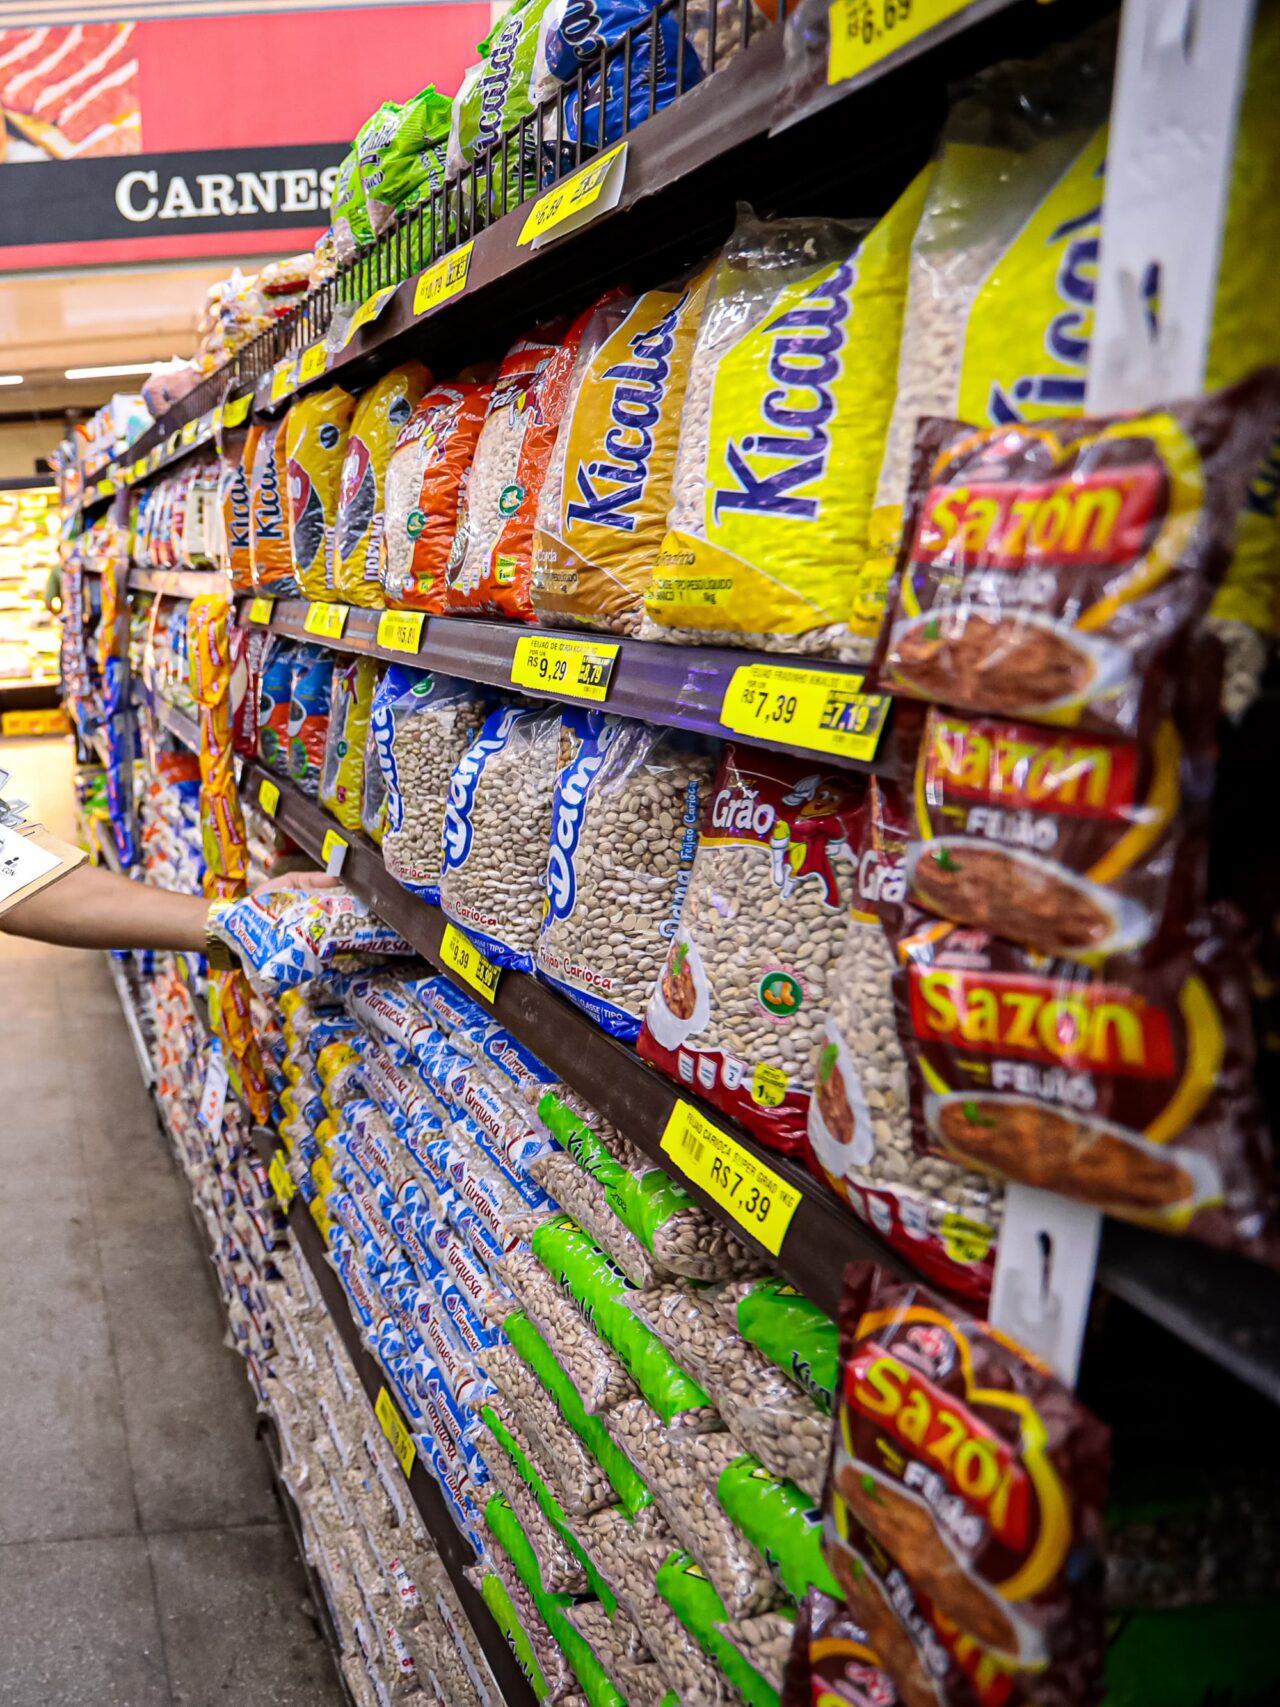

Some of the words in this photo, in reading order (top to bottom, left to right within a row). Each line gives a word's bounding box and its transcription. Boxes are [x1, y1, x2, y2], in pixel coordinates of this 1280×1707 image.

[114, 166, 337, 222] CARNES
[539, 658, 568, 682] 9,29
[754, 691, 799, 725] 7,39
[711, 788, 777, 835] Grão
[856, 848, 908, 902] Grã
[454, 901, 498, 928] Carioca
[452, 946, 471, 970] 9,39
[488, 943, 506, 954] TIPO
[562, 957, 614, 991] Carioca
[365, 990, 407, 1029] Turquesa
[603, 1010, 624, 1022] TIPO
[464, 1087, 501, 1138] Turquesa
[702, 1128, 733, 1158] CARIOCA
[732, 1150, 757, 1175] SUPER
[709, 1157, 772, 1223] R$7,39
[448, 1242, 484, 1300] Turquesa
[428, 1316, 457, 1376] Turquesa
[454, 1306, 481, 1352] Turquesa
